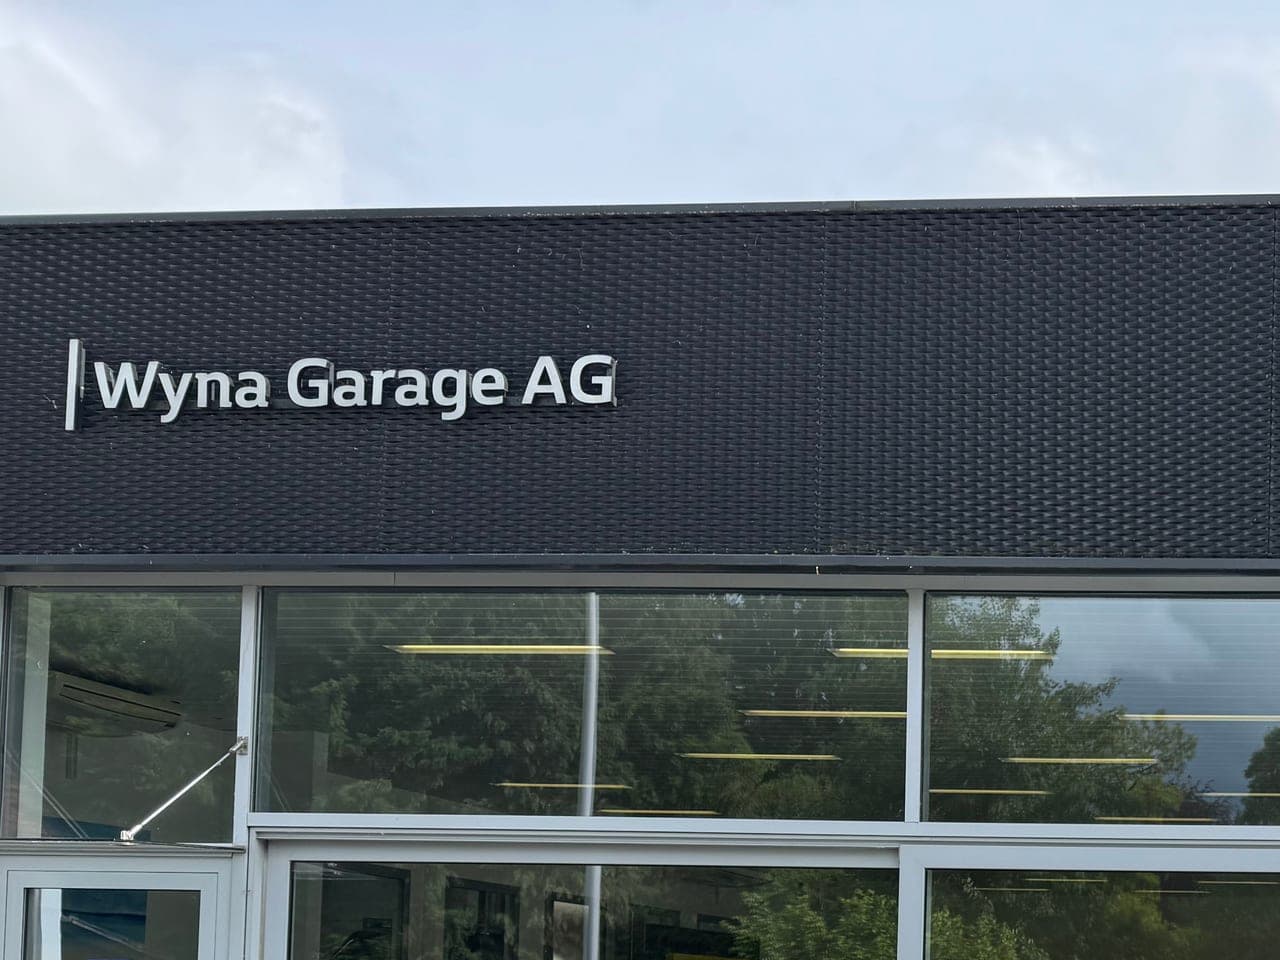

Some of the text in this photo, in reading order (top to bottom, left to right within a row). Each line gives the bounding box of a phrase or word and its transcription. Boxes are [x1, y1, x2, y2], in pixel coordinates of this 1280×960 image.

[94, 353, 616, 423] Wyna Garage AG
